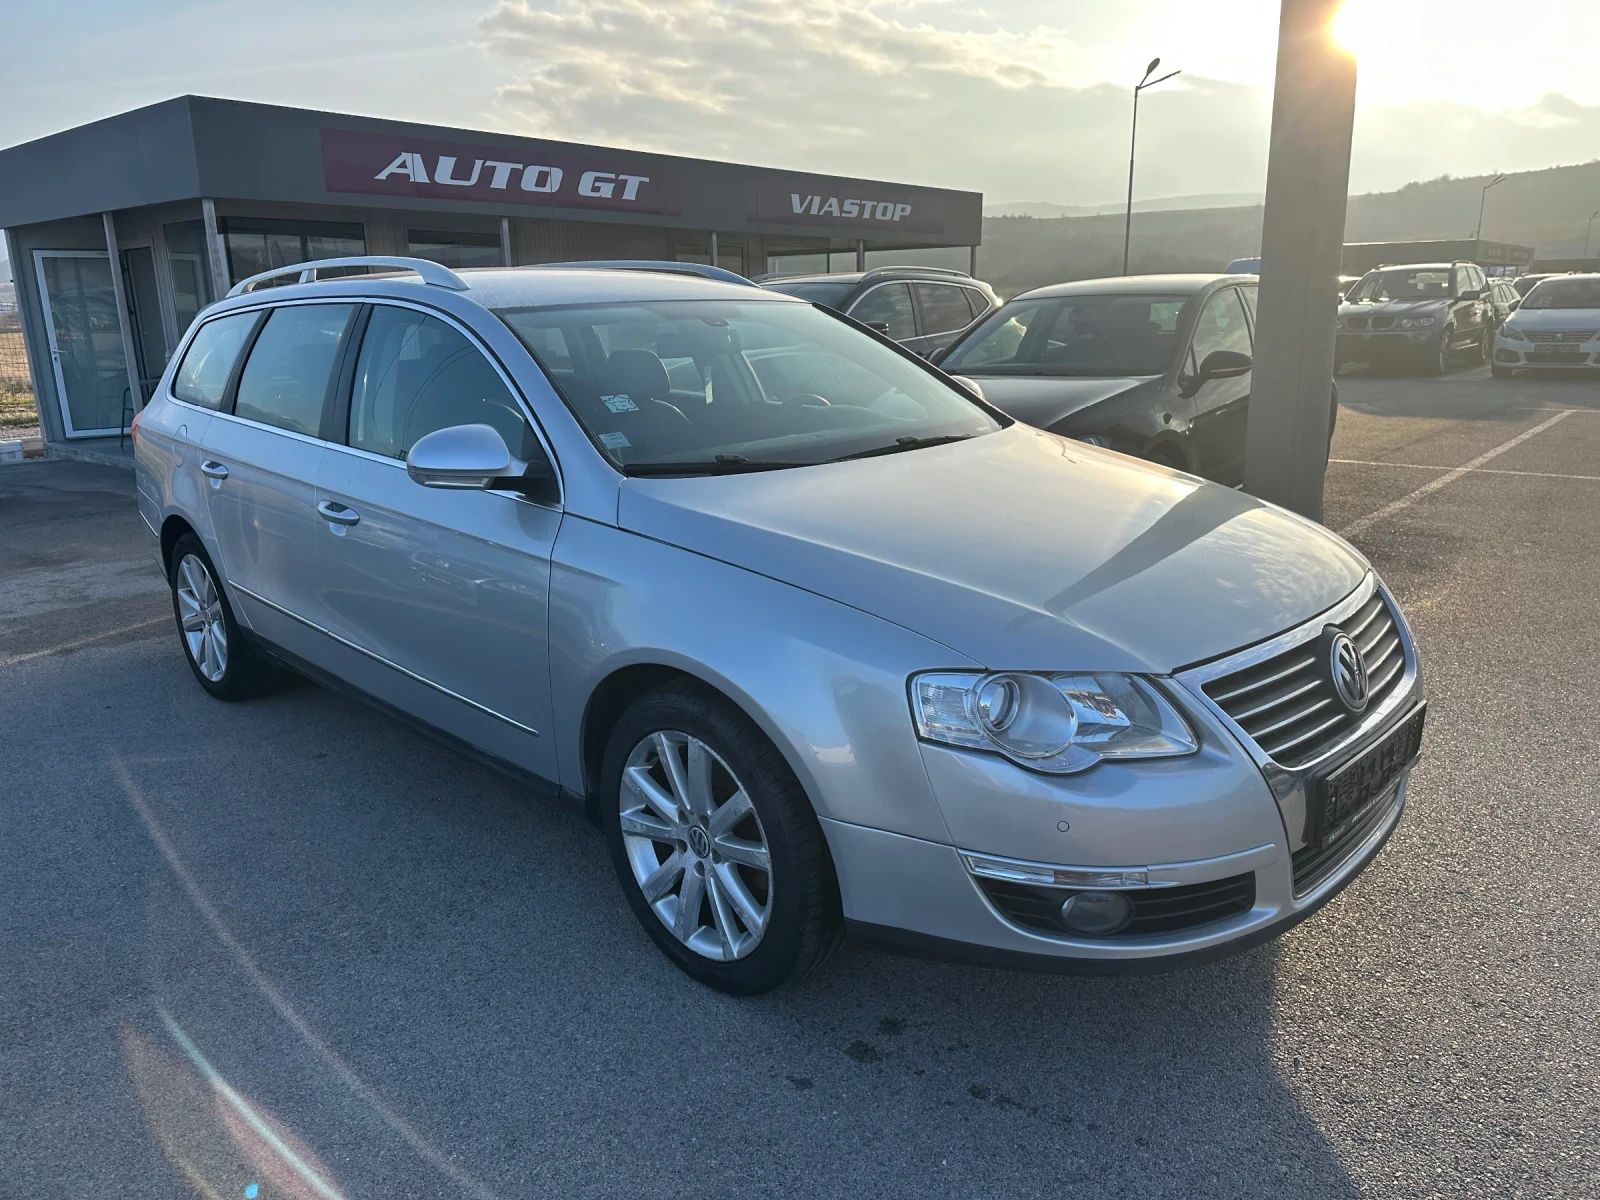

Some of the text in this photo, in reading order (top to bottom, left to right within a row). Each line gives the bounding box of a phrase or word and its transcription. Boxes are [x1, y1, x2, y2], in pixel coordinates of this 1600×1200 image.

[374, 152, 649, 200] AUTO GT
[791, 193, 911, 221] VIASTOP
